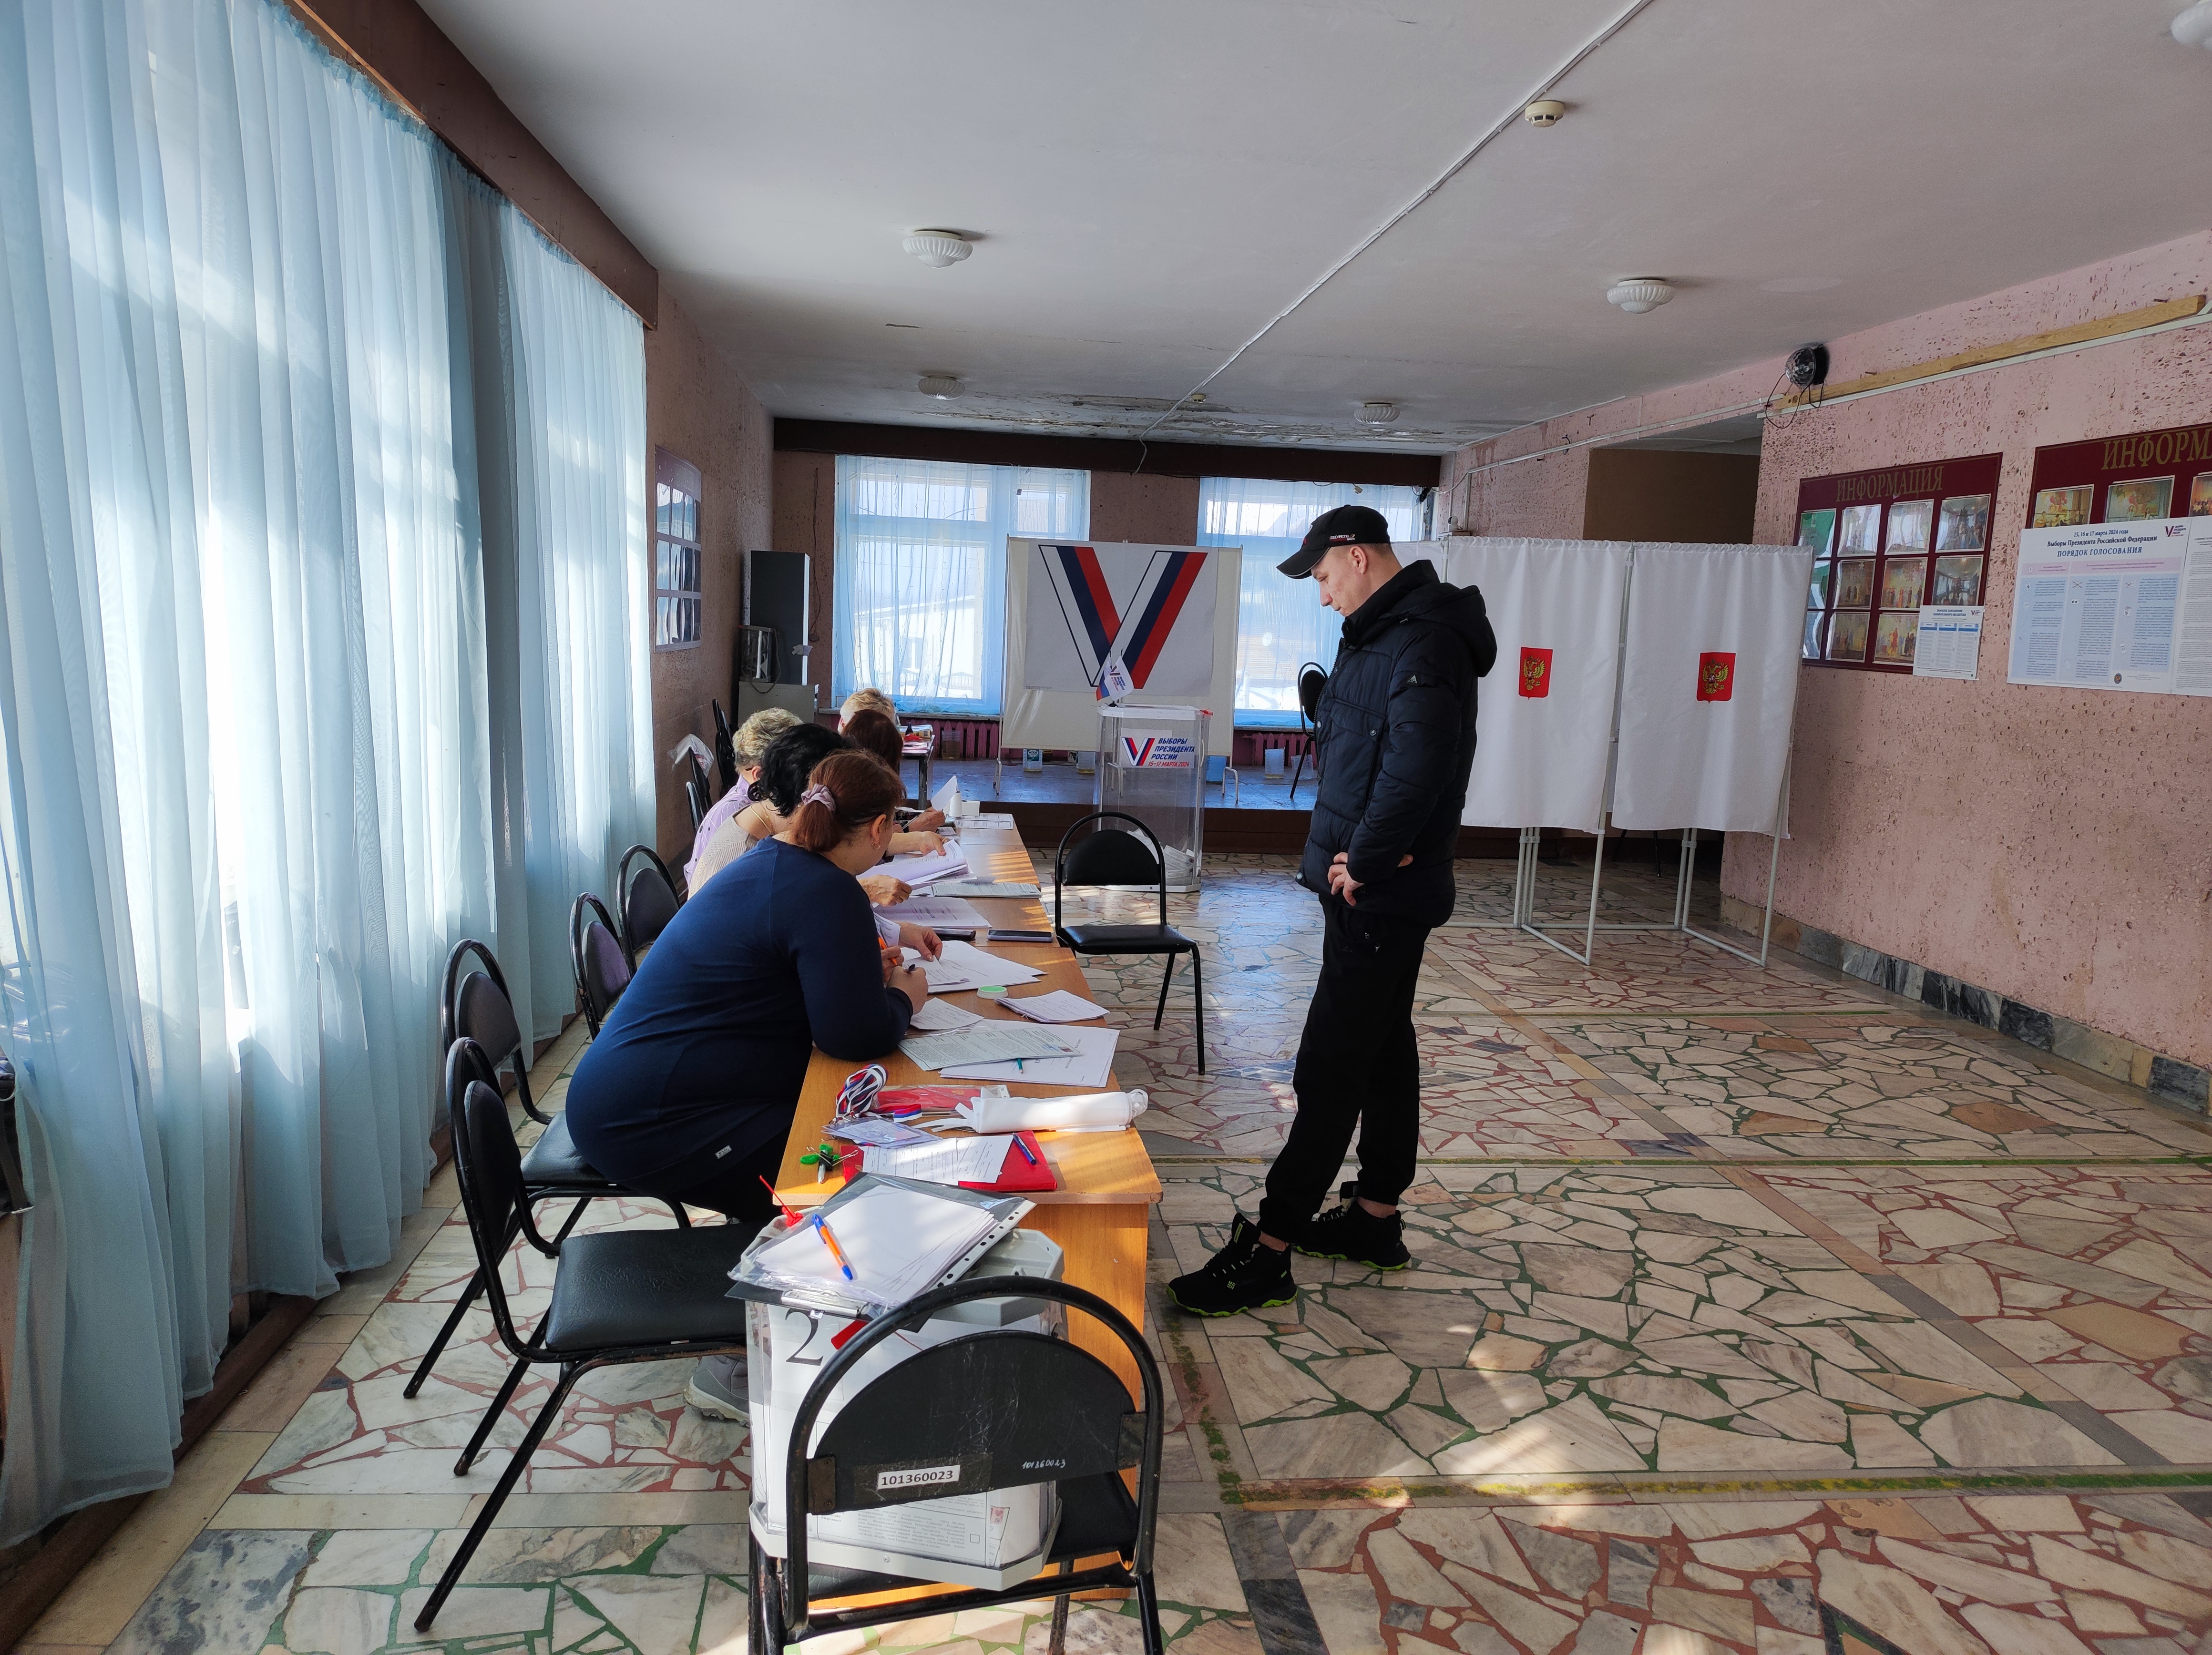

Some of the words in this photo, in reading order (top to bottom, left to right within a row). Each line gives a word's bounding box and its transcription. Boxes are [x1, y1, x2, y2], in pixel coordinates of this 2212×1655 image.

[1836, 466, 1944, 502] ИНФОРМАЦИЯ
[2089, 546, 2142, 555] ГОЛОСОВАНИЯ
[785, 1308, 824, 1366] 2
[1021, 1459, 1066, 1470] 101360023
[881, 1470, 953, 1486] 101360023
